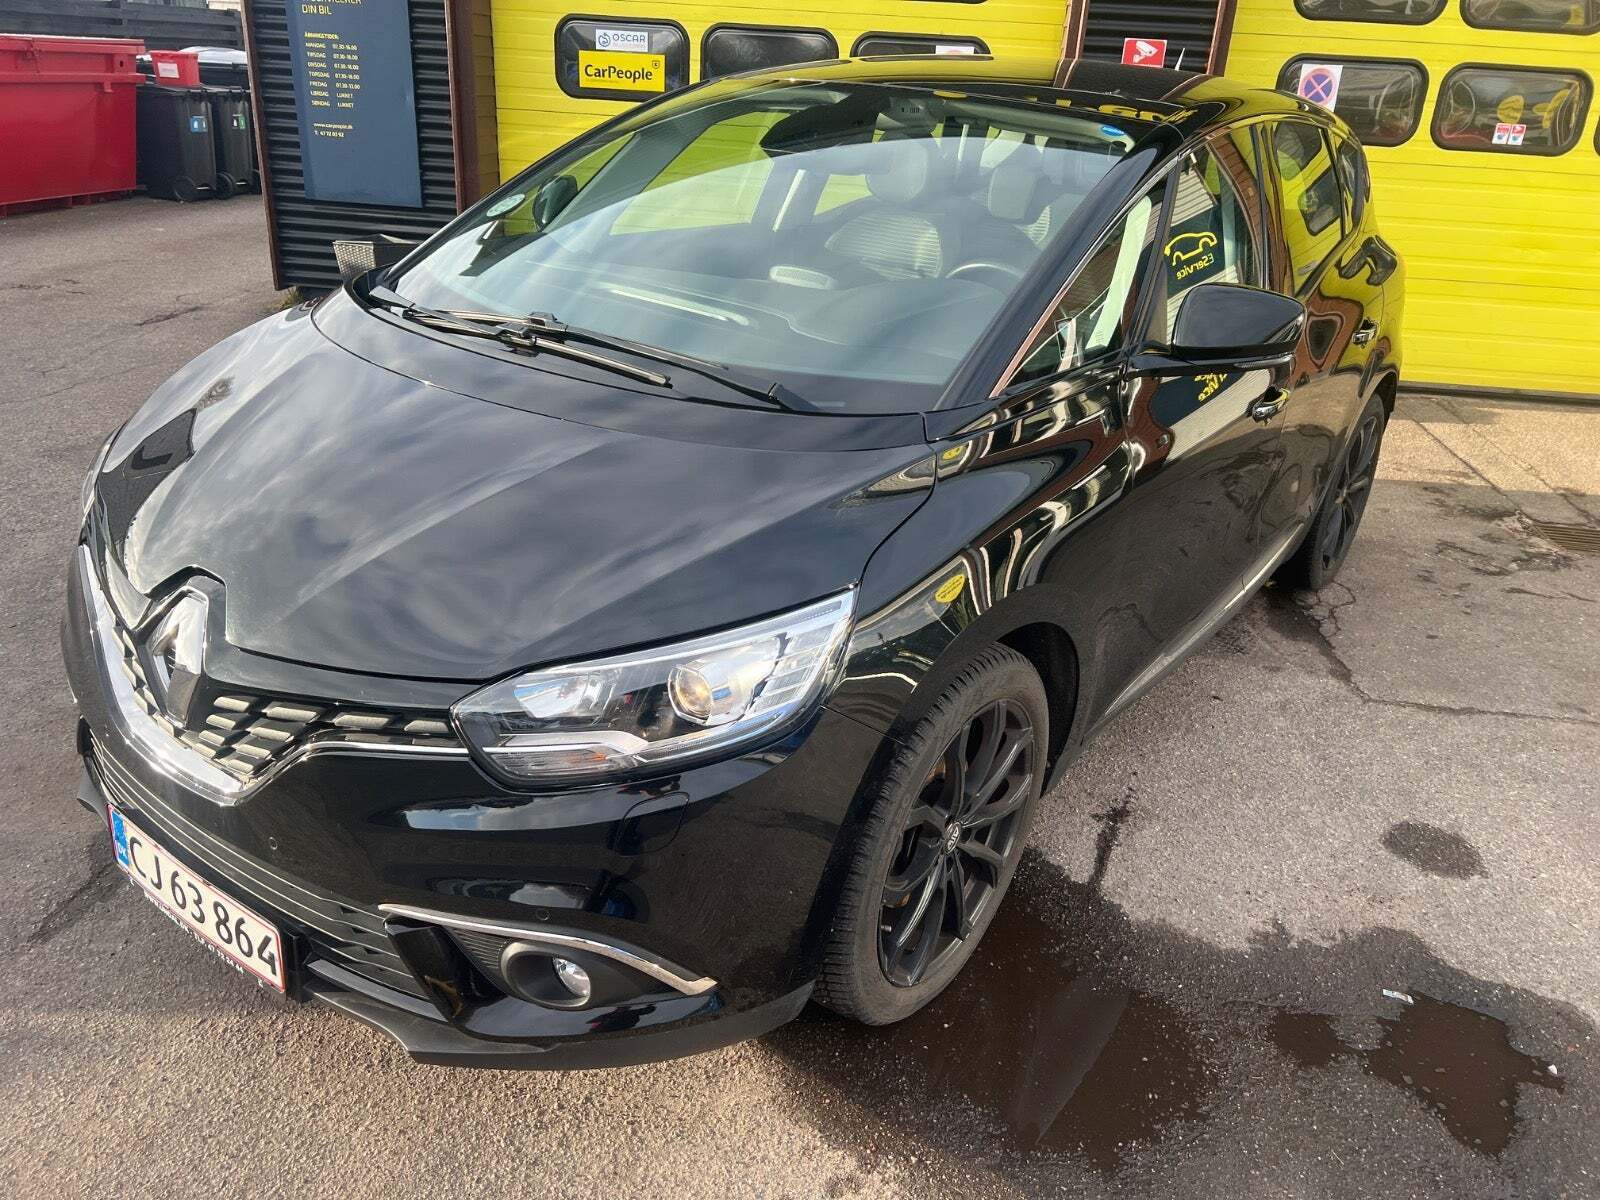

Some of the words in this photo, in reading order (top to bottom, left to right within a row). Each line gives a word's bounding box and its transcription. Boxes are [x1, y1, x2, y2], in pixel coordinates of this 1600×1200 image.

[302, 4, 317, 14] DIN
[319, 5, 332, 15] BIL
[612, 33, 646, 43] OSCAR
[584, 64, 653, 83] CarPeople
[129, 836, 162, 890] CJ
[170, 870, 206, 924] 63
[213, 900, 277, 977] 864
